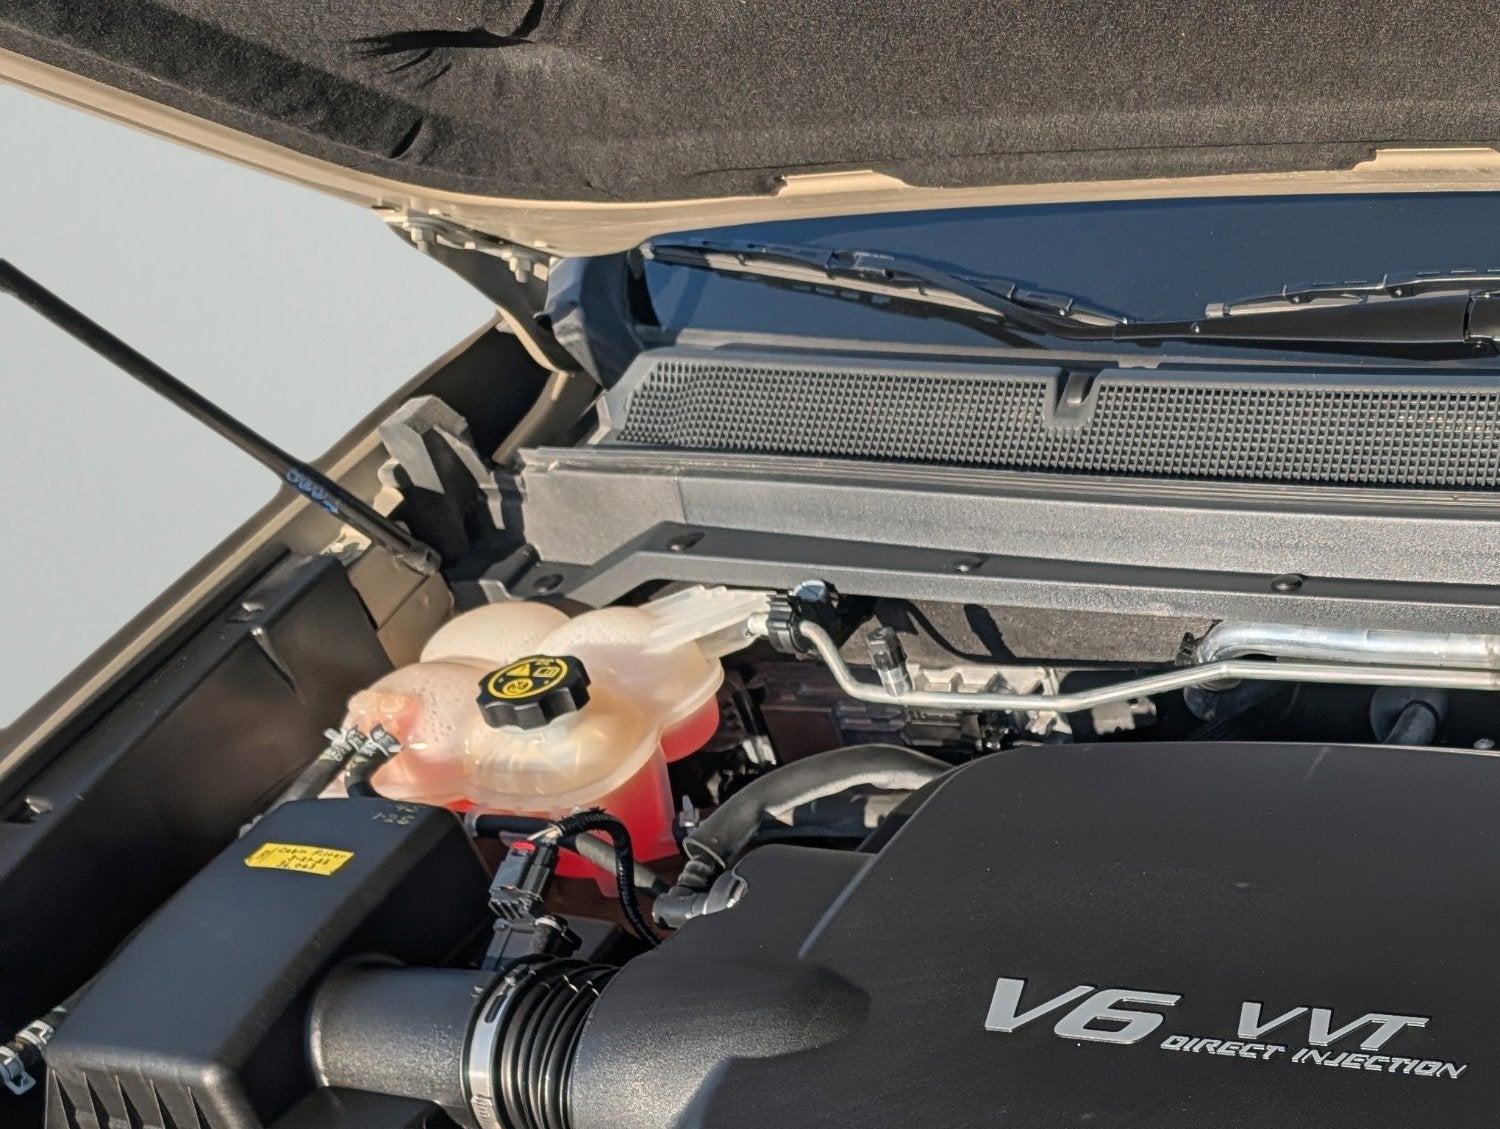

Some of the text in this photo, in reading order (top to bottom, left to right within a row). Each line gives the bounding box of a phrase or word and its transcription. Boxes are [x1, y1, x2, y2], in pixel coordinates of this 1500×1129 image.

[984, 977, 1183, 1045] V6
[1238, 1001, 1431, 1051] VVT
[1160, 1034, 1469, 1079] DIRECT INJECTION
